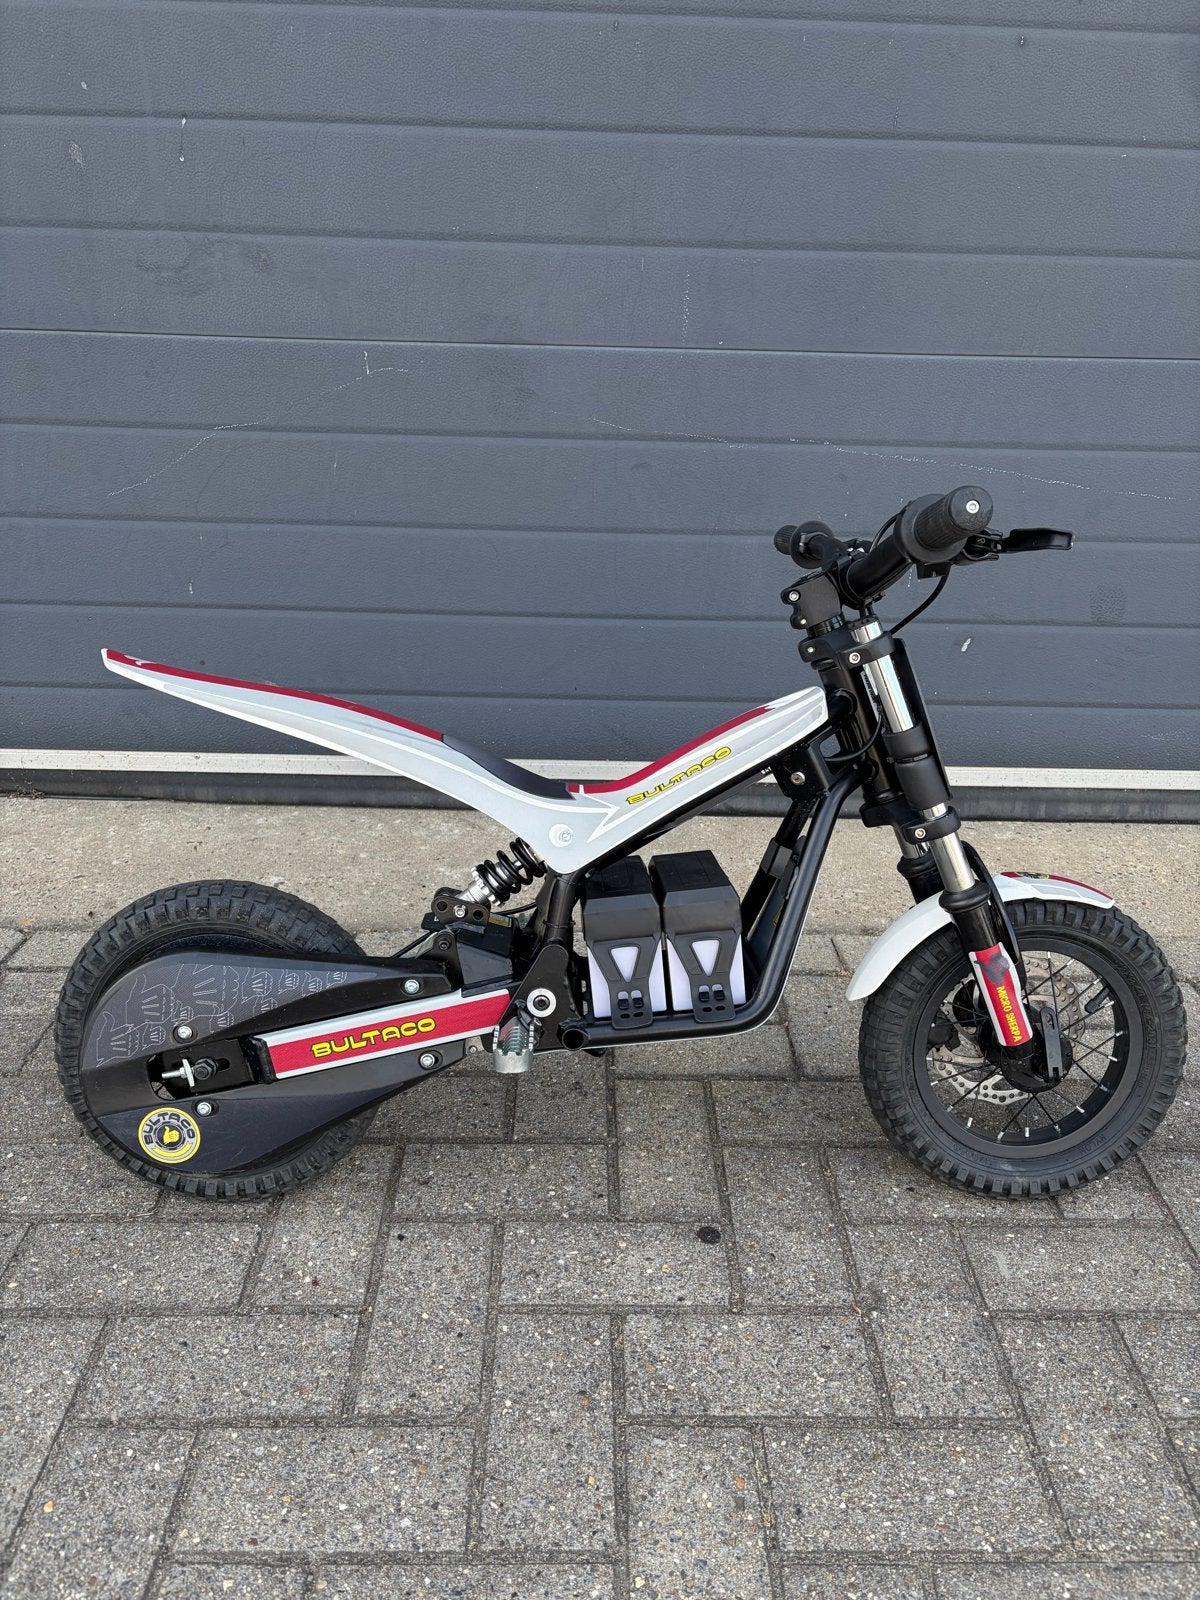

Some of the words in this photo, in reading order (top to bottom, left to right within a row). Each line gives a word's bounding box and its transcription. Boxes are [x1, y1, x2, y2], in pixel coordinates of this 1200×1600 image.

[626, 746, 732, 805] BULTACO
[311, 1017, 436, 1058] BULTACO
[996, 985, 1013, 1013] MICRO
[1005, 1012, 1022, 1042] SHERPA
[143, 1112, 195, 1145] BULTACO
